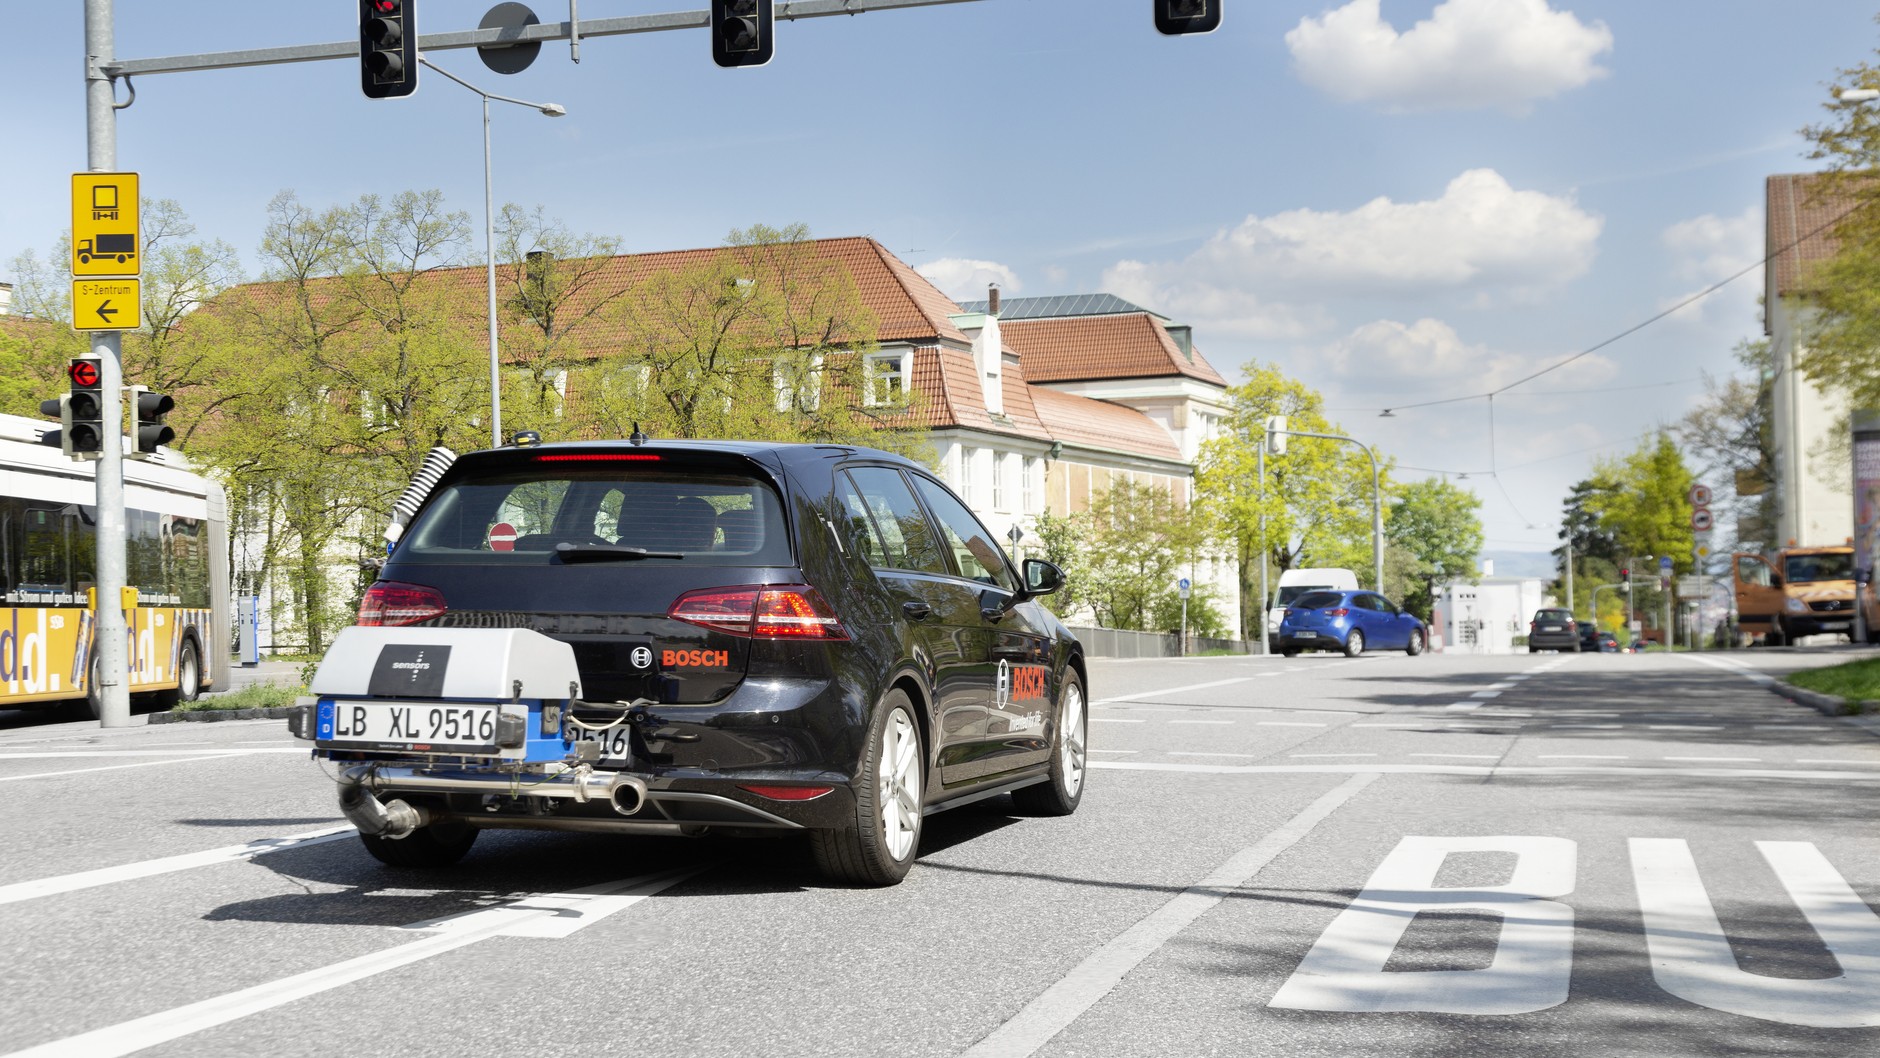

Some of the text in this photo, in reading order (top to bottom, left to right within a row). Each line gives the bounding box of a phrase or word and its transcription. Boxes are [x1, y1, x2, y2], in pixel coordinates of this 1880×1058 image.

[82, 284, 132, 296] S-Zentrum
[662, 649, 728, 667] BOSCH
[1013, 666, 1044, 702] BOSCH
[322, 723, 331, 734] D
[335, 705, 494, 741] LB XL 9516
